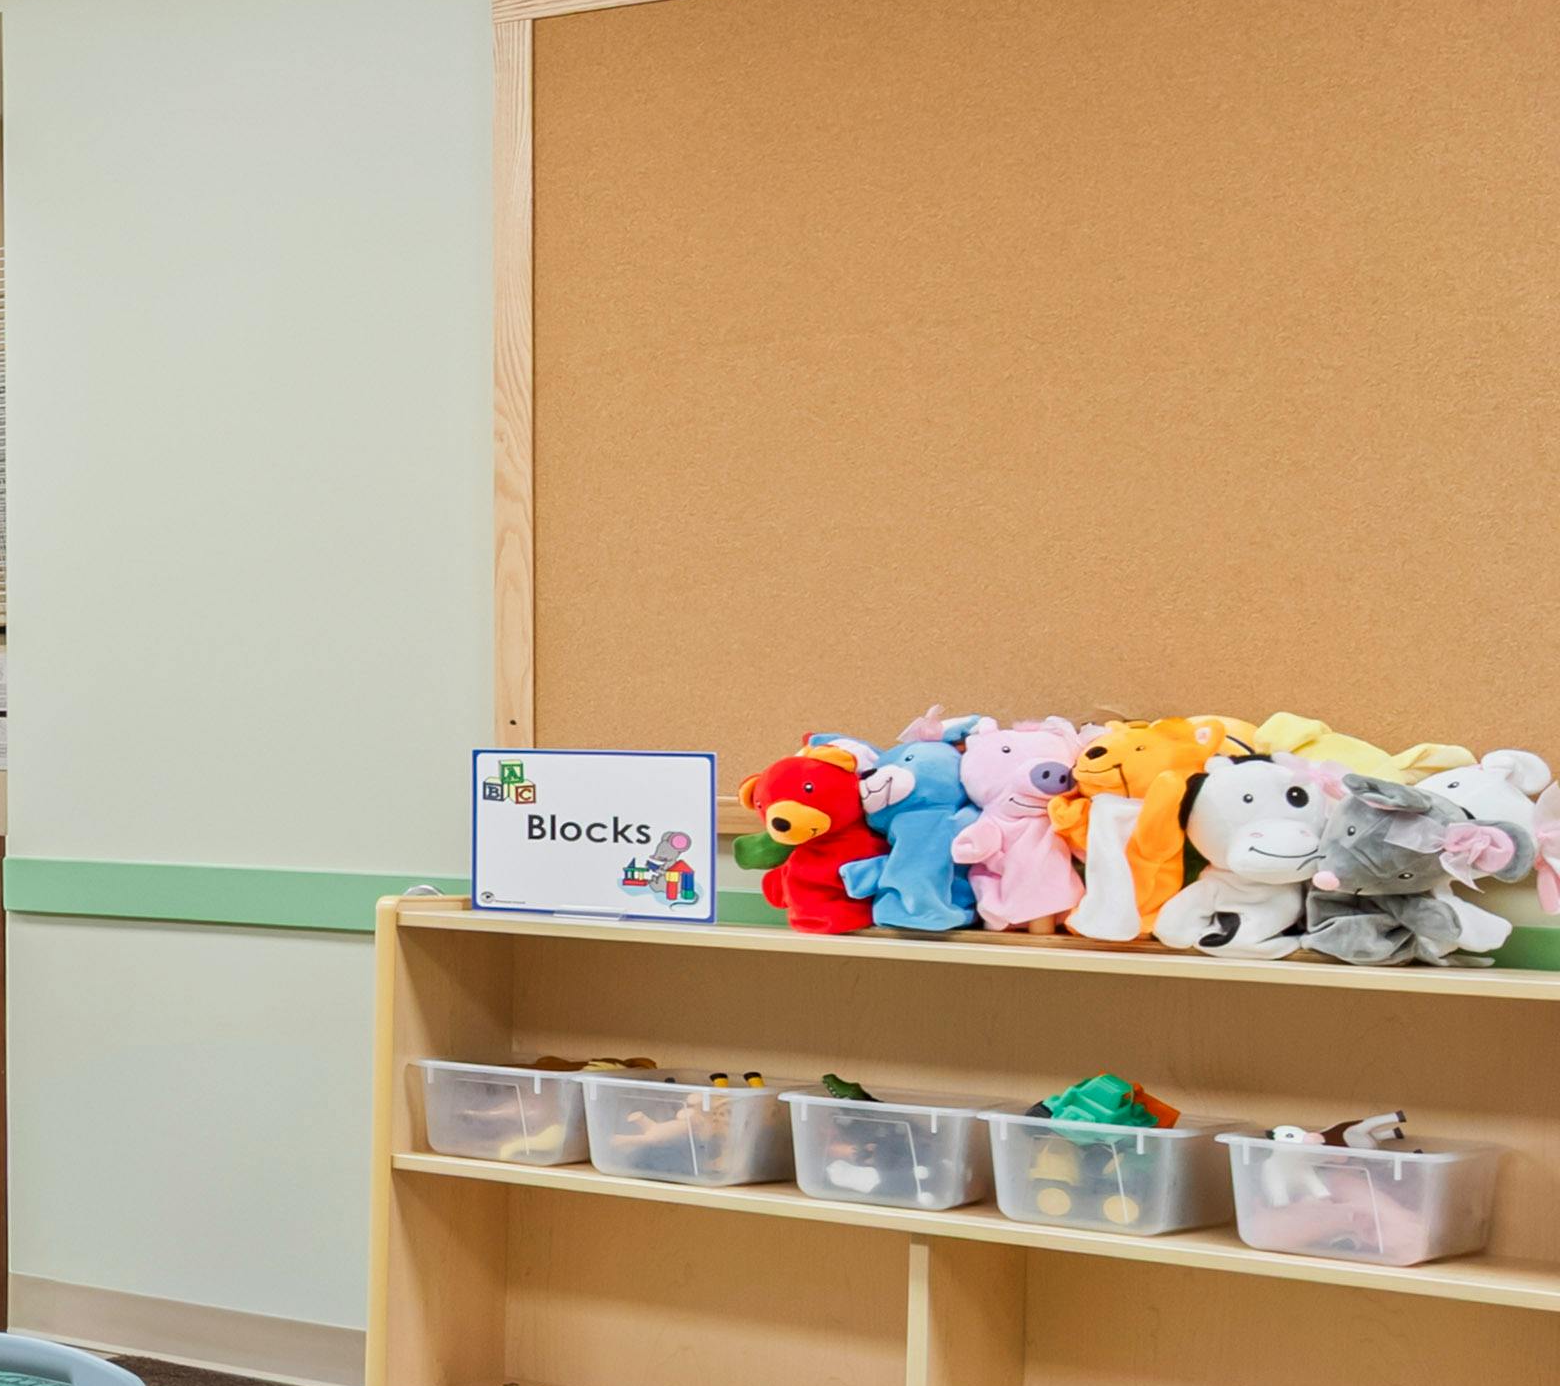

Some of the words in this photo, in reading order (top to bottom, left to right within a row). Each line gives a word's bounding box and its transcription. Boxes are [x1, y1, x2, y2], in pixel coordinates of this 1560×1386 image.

[504, 766, 520, 782] A
[487, 785, 501, 800] B
[519, 788, 533, 802] C
[527, 814, 651, 845] Blocks
